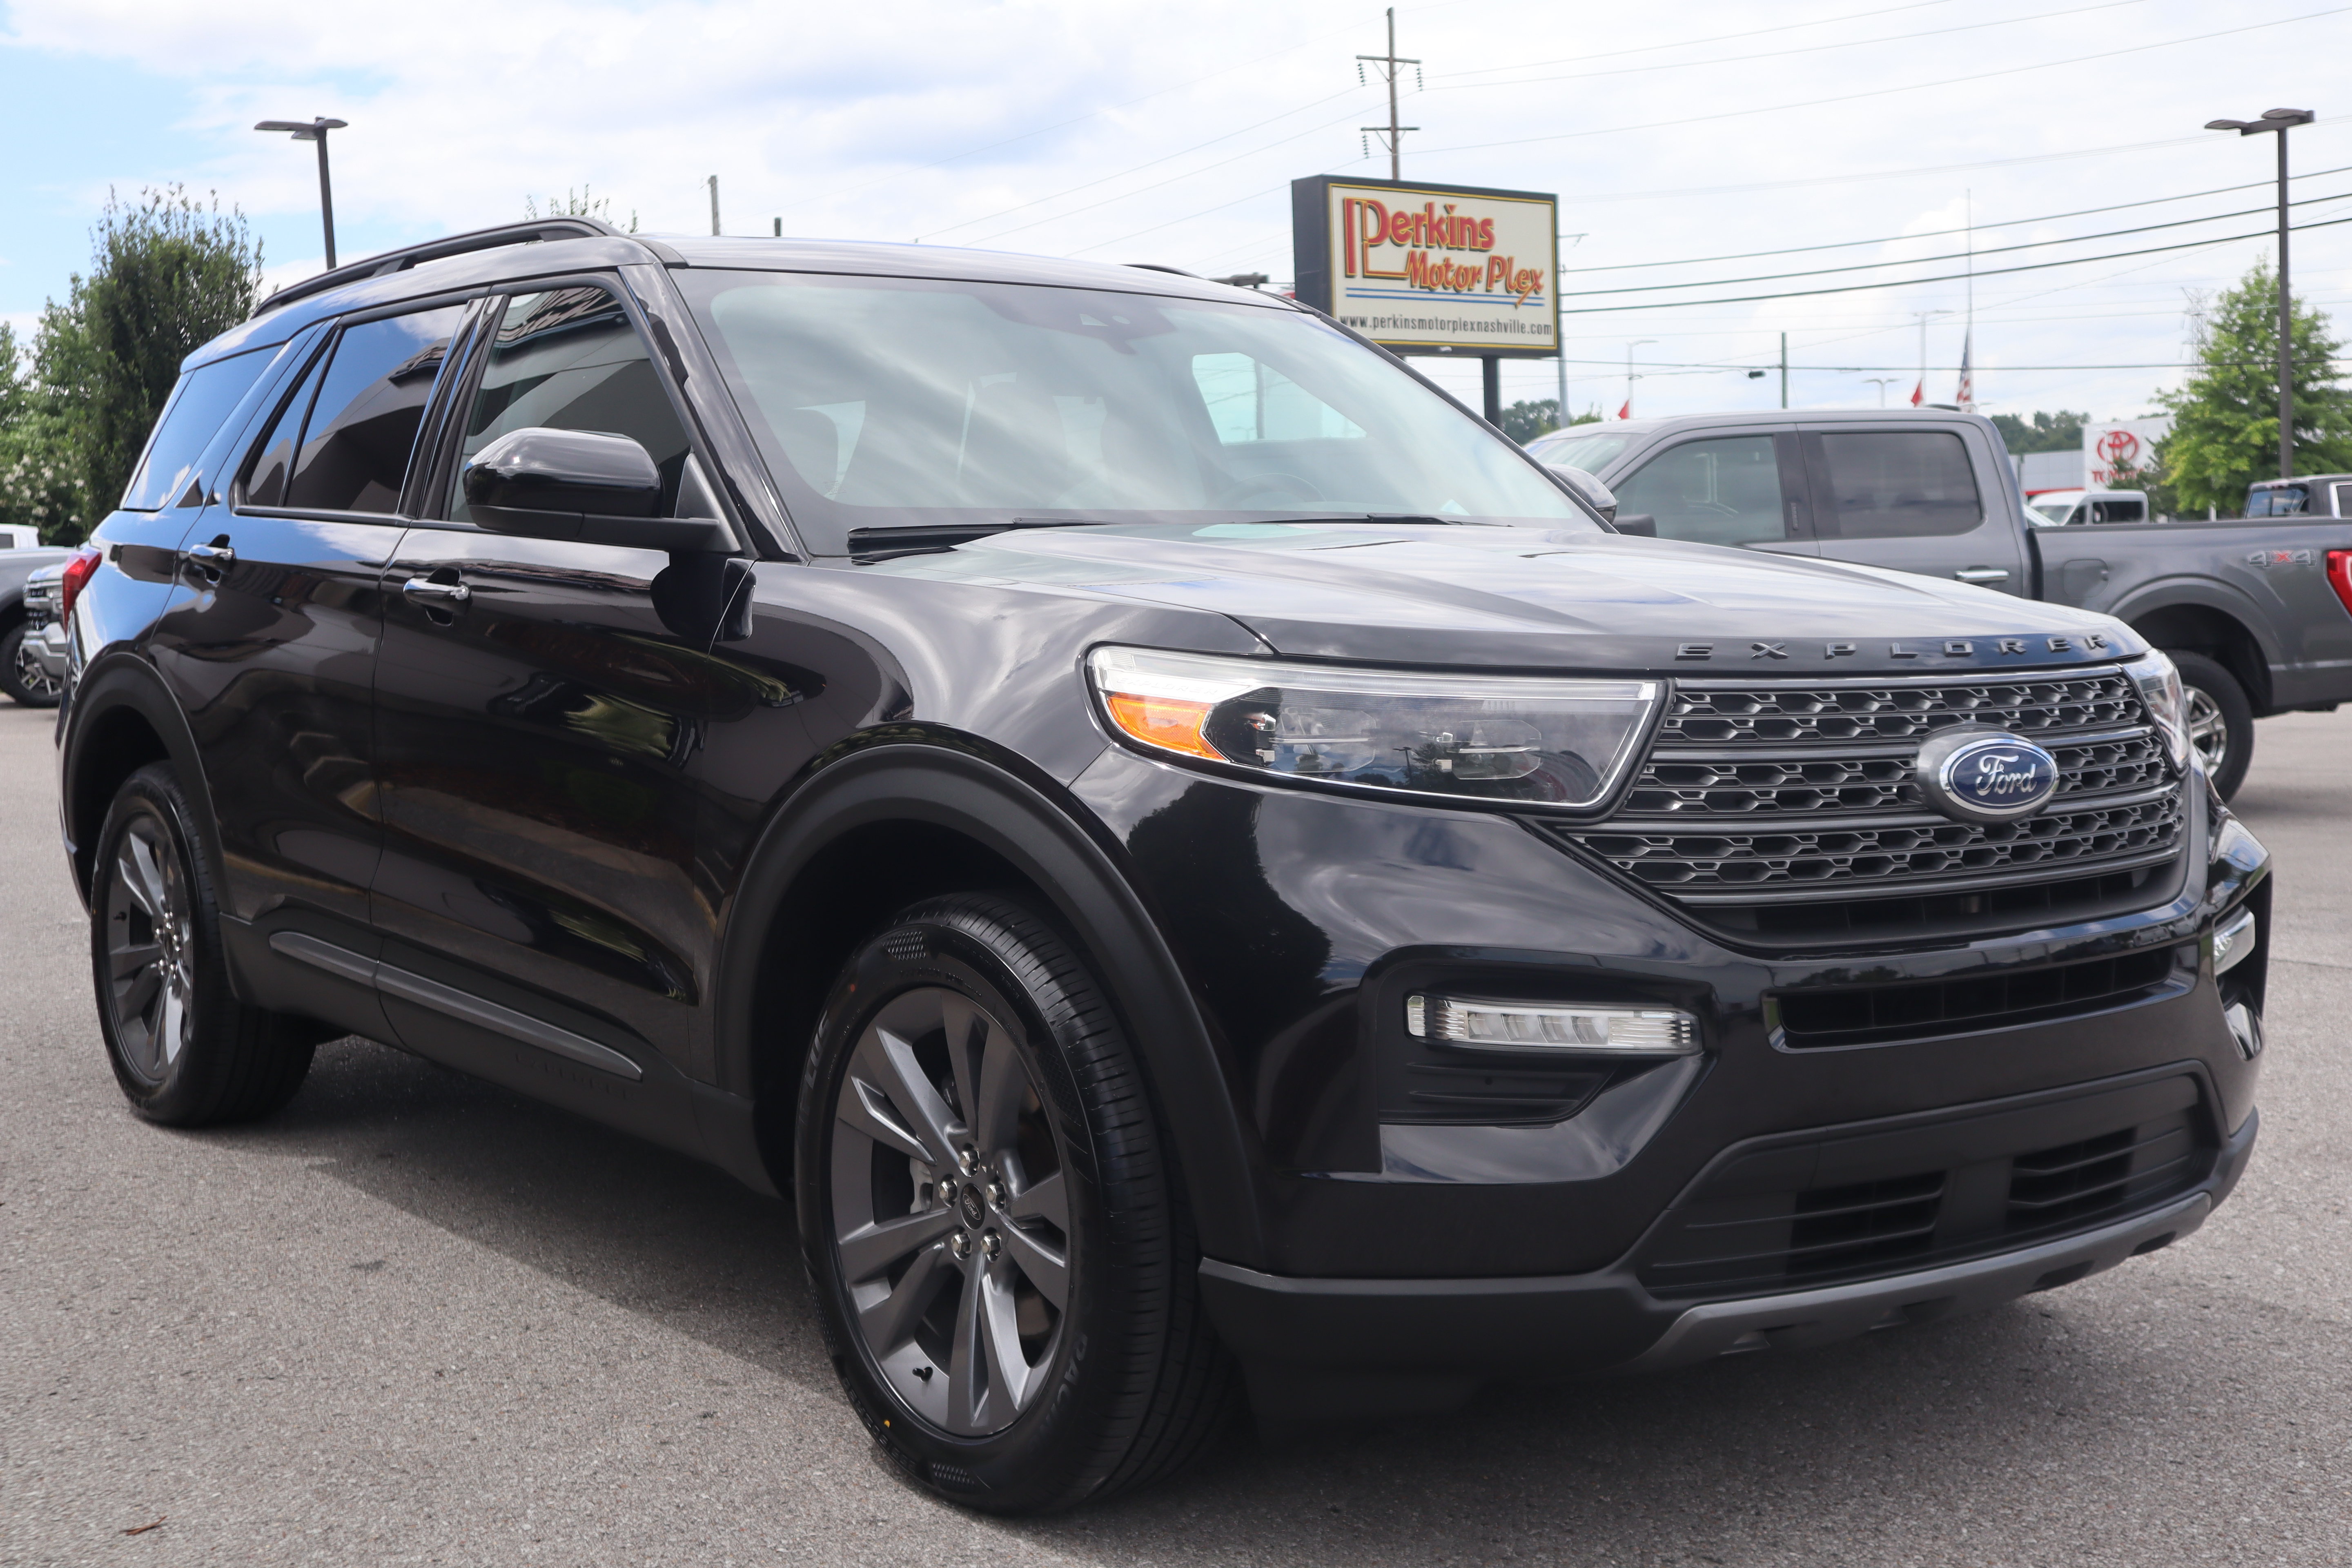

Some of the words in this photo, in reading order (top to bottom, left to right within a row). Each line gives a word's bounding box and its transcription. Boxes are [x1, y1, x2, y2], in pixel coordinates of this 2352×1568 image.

[1344, 197, 1496, 277] Perkins
[1406, 250, 1484, 292] Motor
[1487, 255, 1544, 308] Plex
[1340, 314, 1552, 336] www.perkinsmotorplexnashville.com
[1676, 633, 2108, 661] EXPLORER
[1976, 755, 2038, 796] Ford
[964, 1198, 978, 1217] Ford
